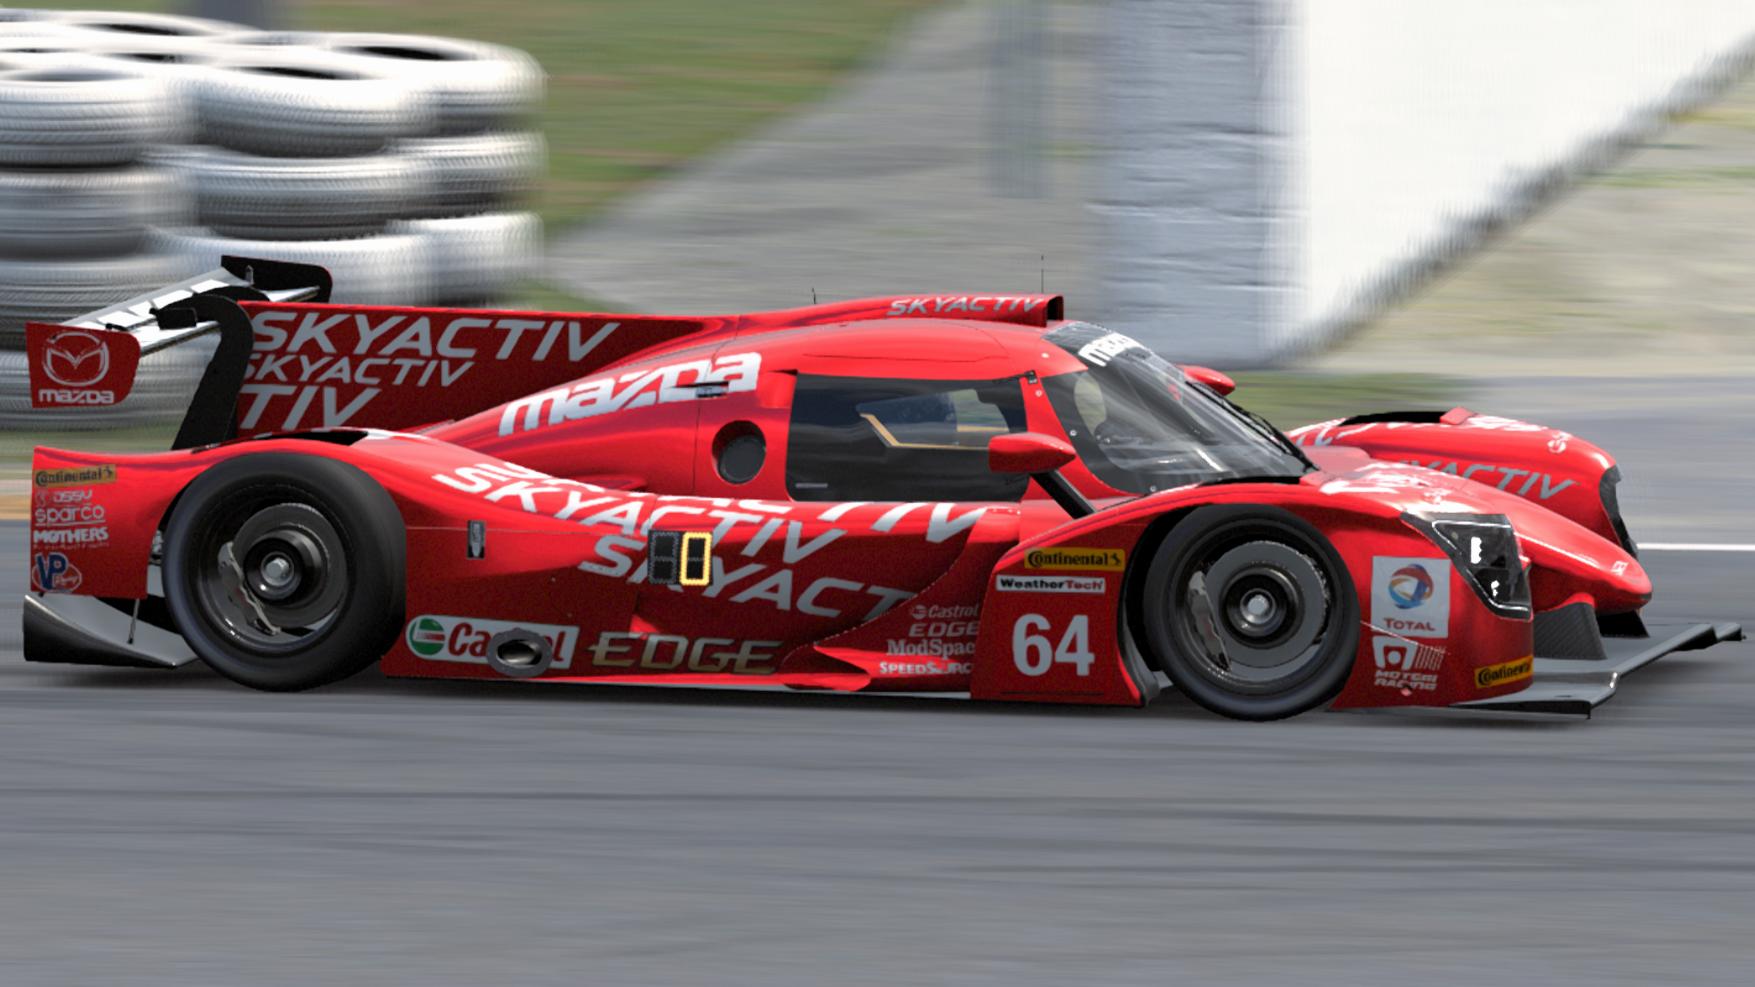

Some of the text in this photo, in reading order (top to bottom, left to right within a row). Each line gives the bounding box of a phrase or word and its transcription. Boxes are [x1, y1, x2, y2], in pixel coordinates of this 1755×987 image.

[887, 296, 1046, 315] SKYACTIV
[252, 310, 621, 362] SKYACTIV
[38, 389, 114, 404] mazda
[498, 351, 762, 436] mazda
[240, 384, 382, 431] TIV
[34, 527, 109, 544] MOTHERS
[1028, 550, 1108, 568] Continental
[36, 552, 68, 590] VP
[578, 534, 918, 621] SYACT
[1000, 578, 1102, 591] WeatherTech
[928, 605, 978, 618] Castrol
[908, 621, 980, 637] EDGE
[1384, 617, 1436, 631] TOTAL
[588, 631, 783, 675] EDGE
[1012, 613, 1095, 676] 64
